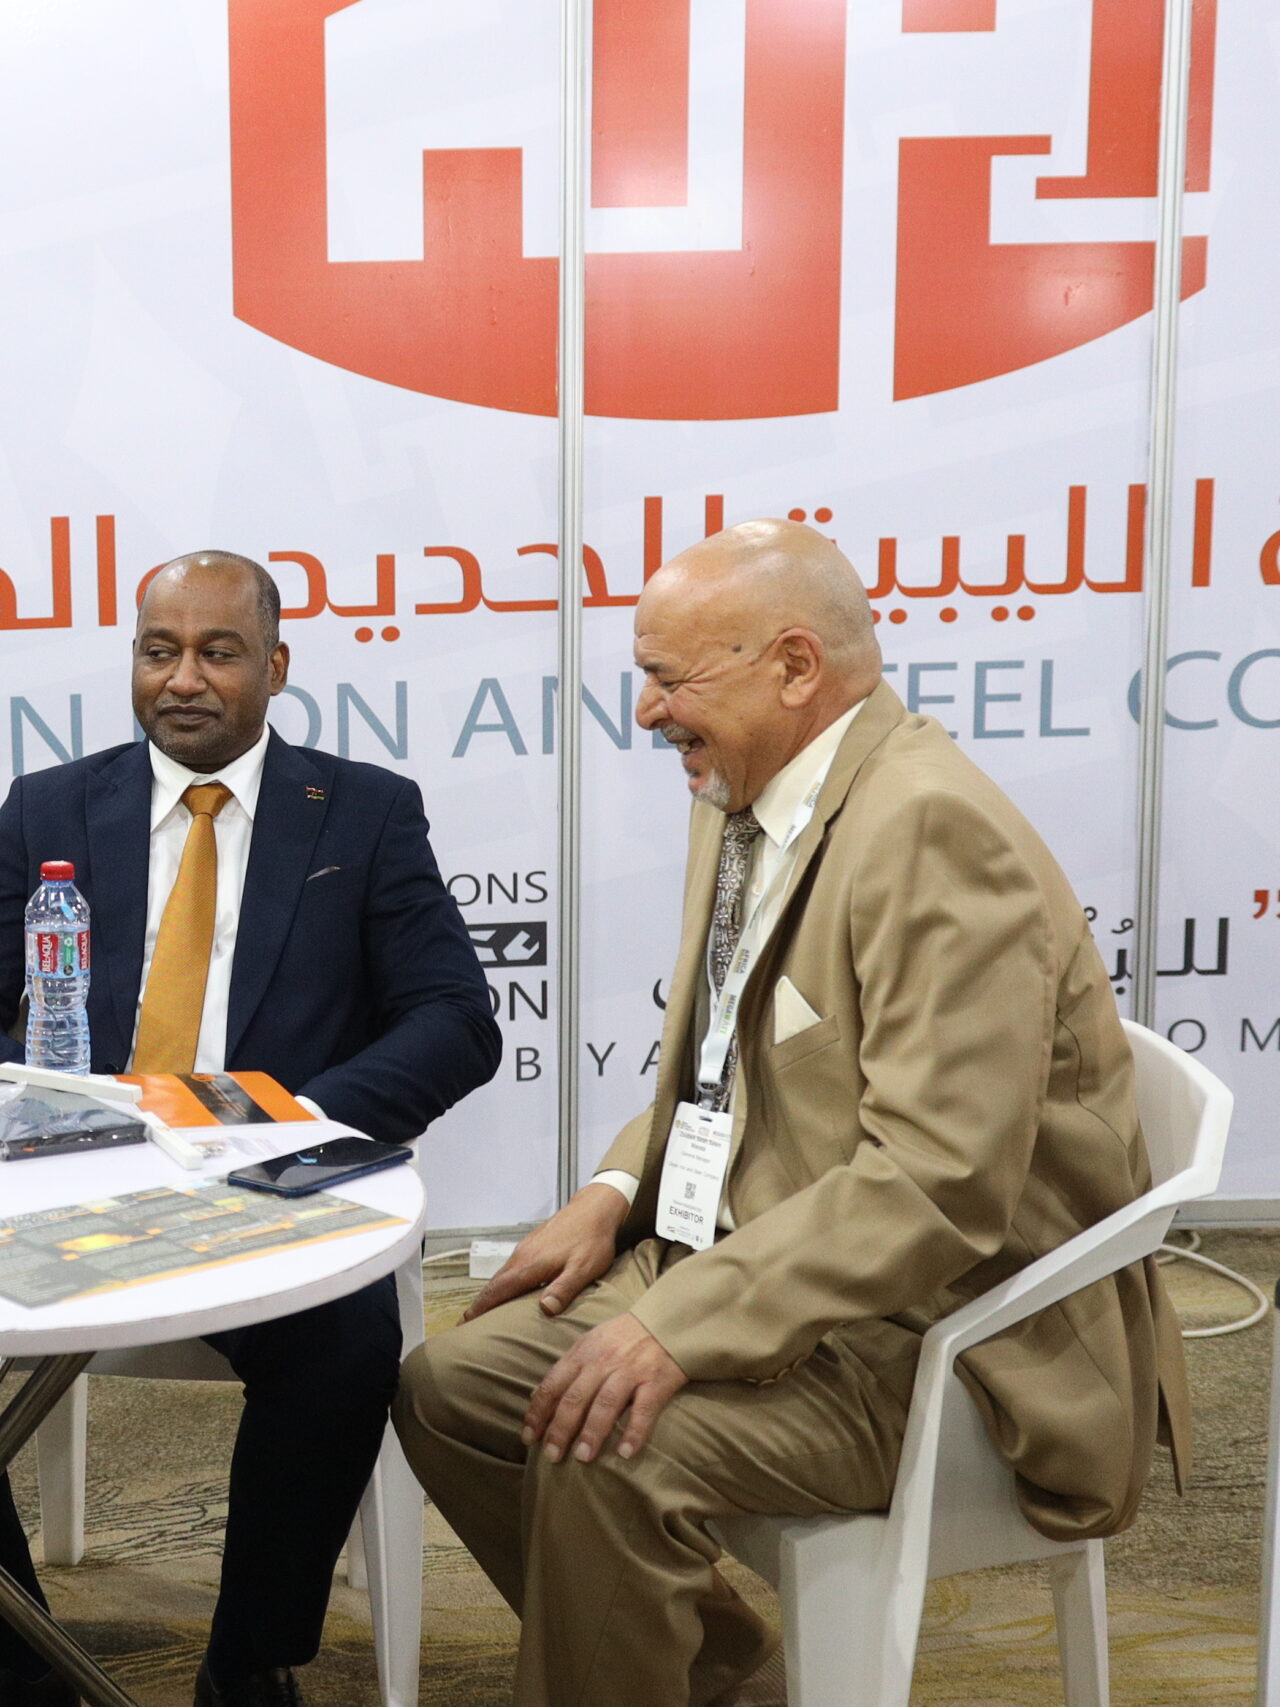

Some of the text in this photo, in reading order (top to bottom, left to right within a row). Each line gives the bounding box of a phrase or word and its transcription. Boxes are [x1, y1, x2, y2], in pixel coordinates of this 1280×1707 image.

[788, 477, 1215, 624] الليبي
[452, 671, 677, 759] AN
[882, 657, 1091, 740] EEL
[669, 1206, 705, 1225] EXHIBITOR
